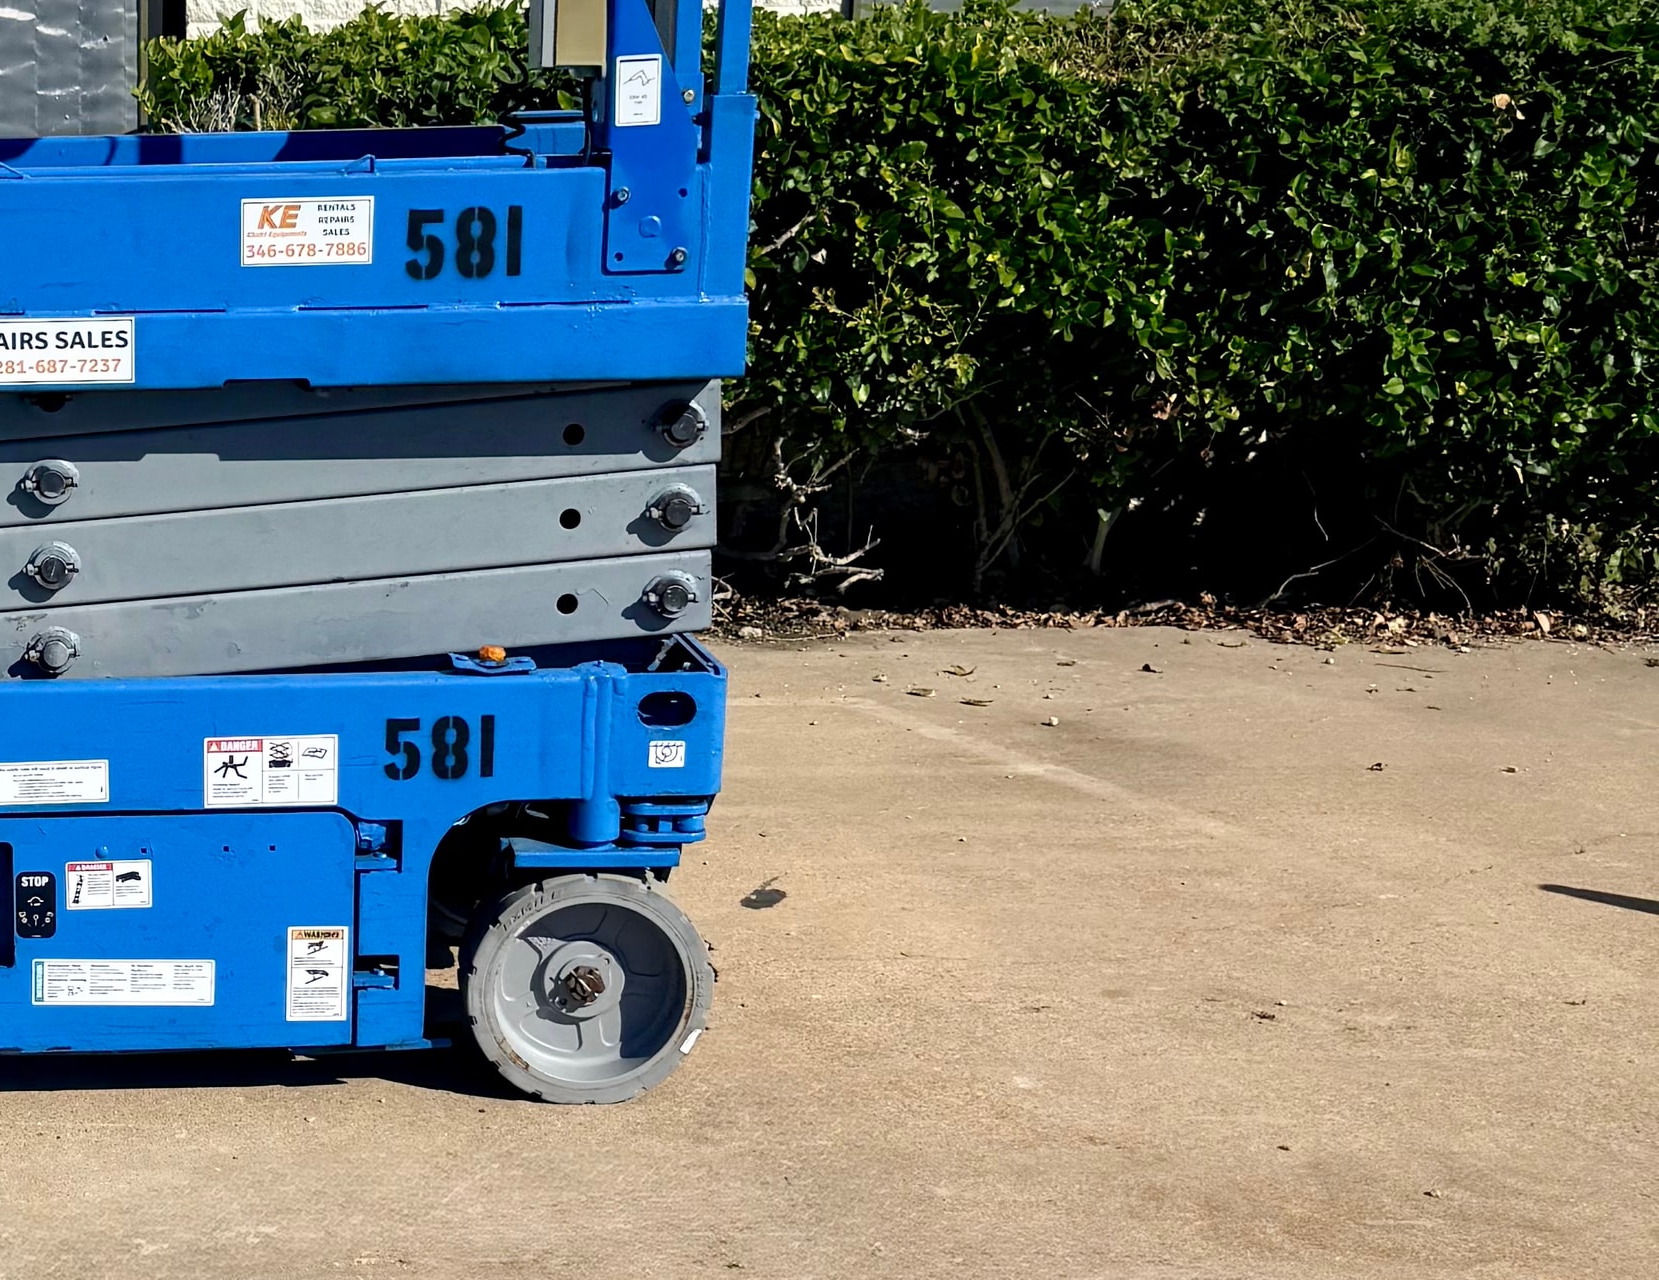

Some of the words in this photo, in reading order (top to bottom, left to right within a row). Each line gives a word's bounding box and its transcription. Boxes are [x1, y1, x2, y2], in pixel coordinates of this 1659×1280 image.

[317, 203, 356, 212] RENTALS
[257, 204, 302, 230] KE
[318, 215, 355, 224] REPAIRS
[322, 228, 350, 236] SALES
[405, 205, 523, 280] 581
[245, 242, 367, 259] 346-678-7886
[55, 329, 129, 350] SALES
[221, 741, 258, 752] DANGER
[383, 714, 495, 781] 581
[21, 876, 49, 887] STOP
